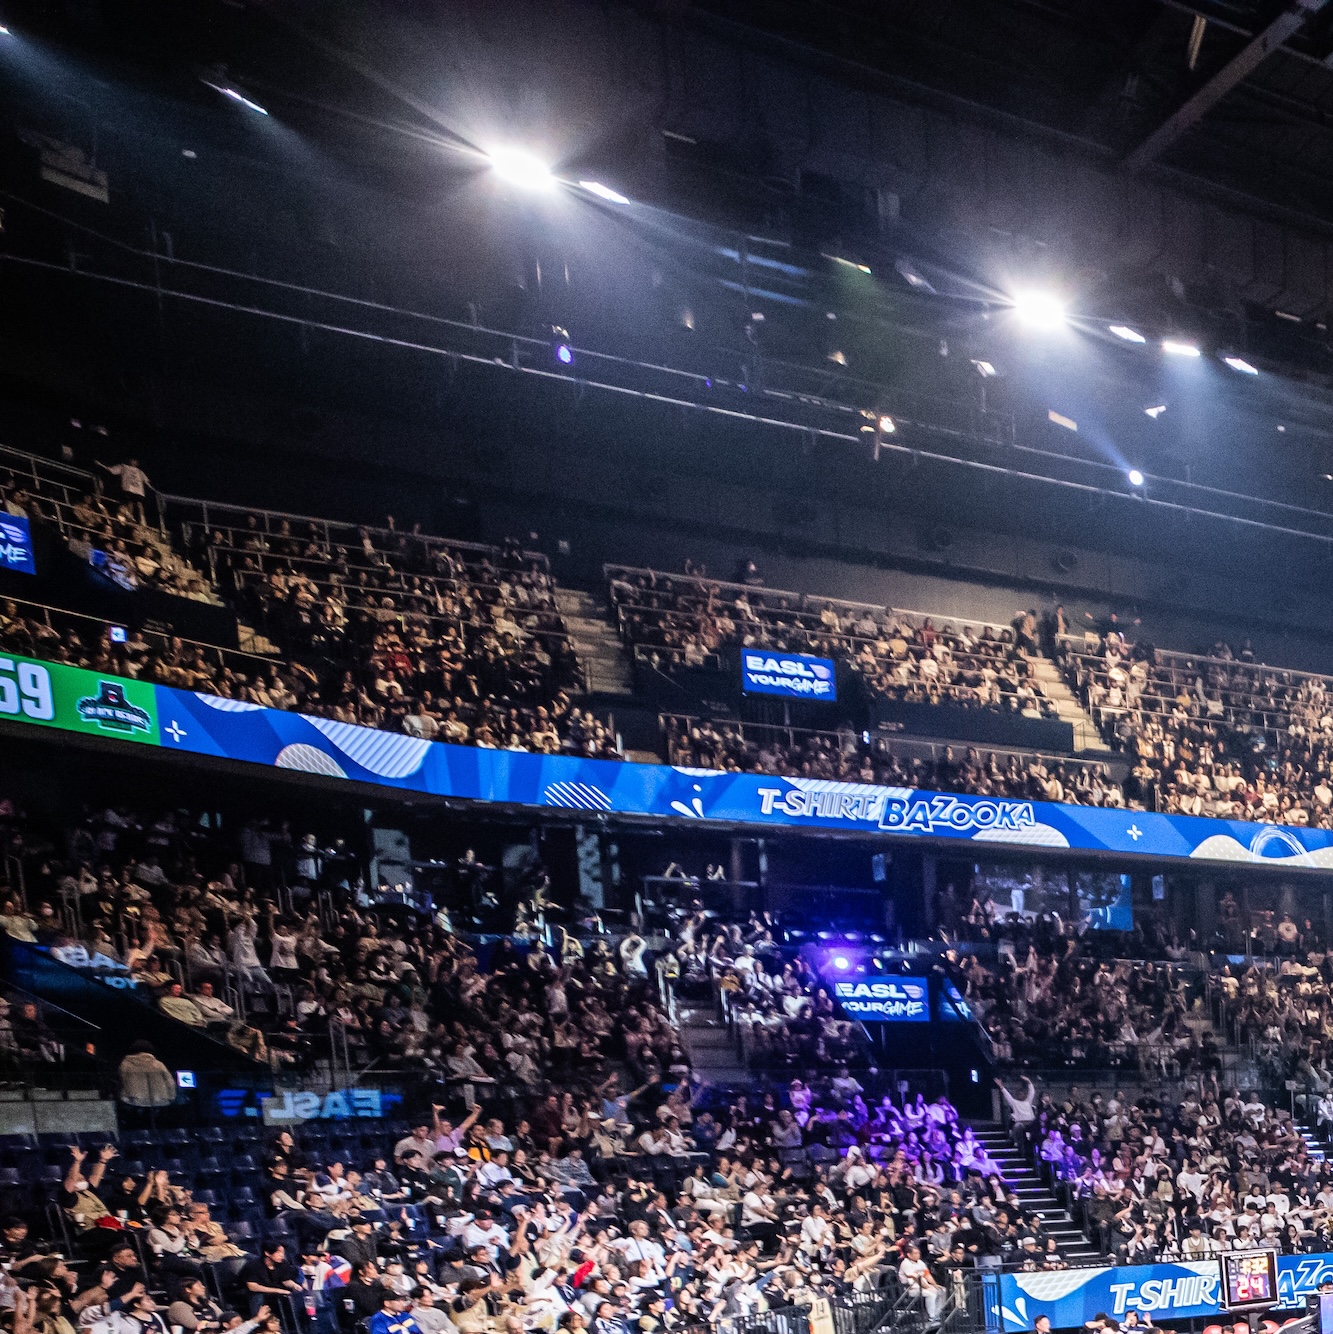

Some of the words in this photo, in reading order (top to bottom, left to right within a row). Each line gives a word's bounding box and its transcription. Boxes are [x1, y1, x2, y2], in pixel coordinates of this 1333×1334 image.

[746, 656, 813, 678] EASL
[758, 788, 877, 820] T-SHIRT
[878, 795, 1036, 832] BAZOOKA
[835, 983, 907, 999] EASL
[1236, 1275, 1265, 1299] 24
